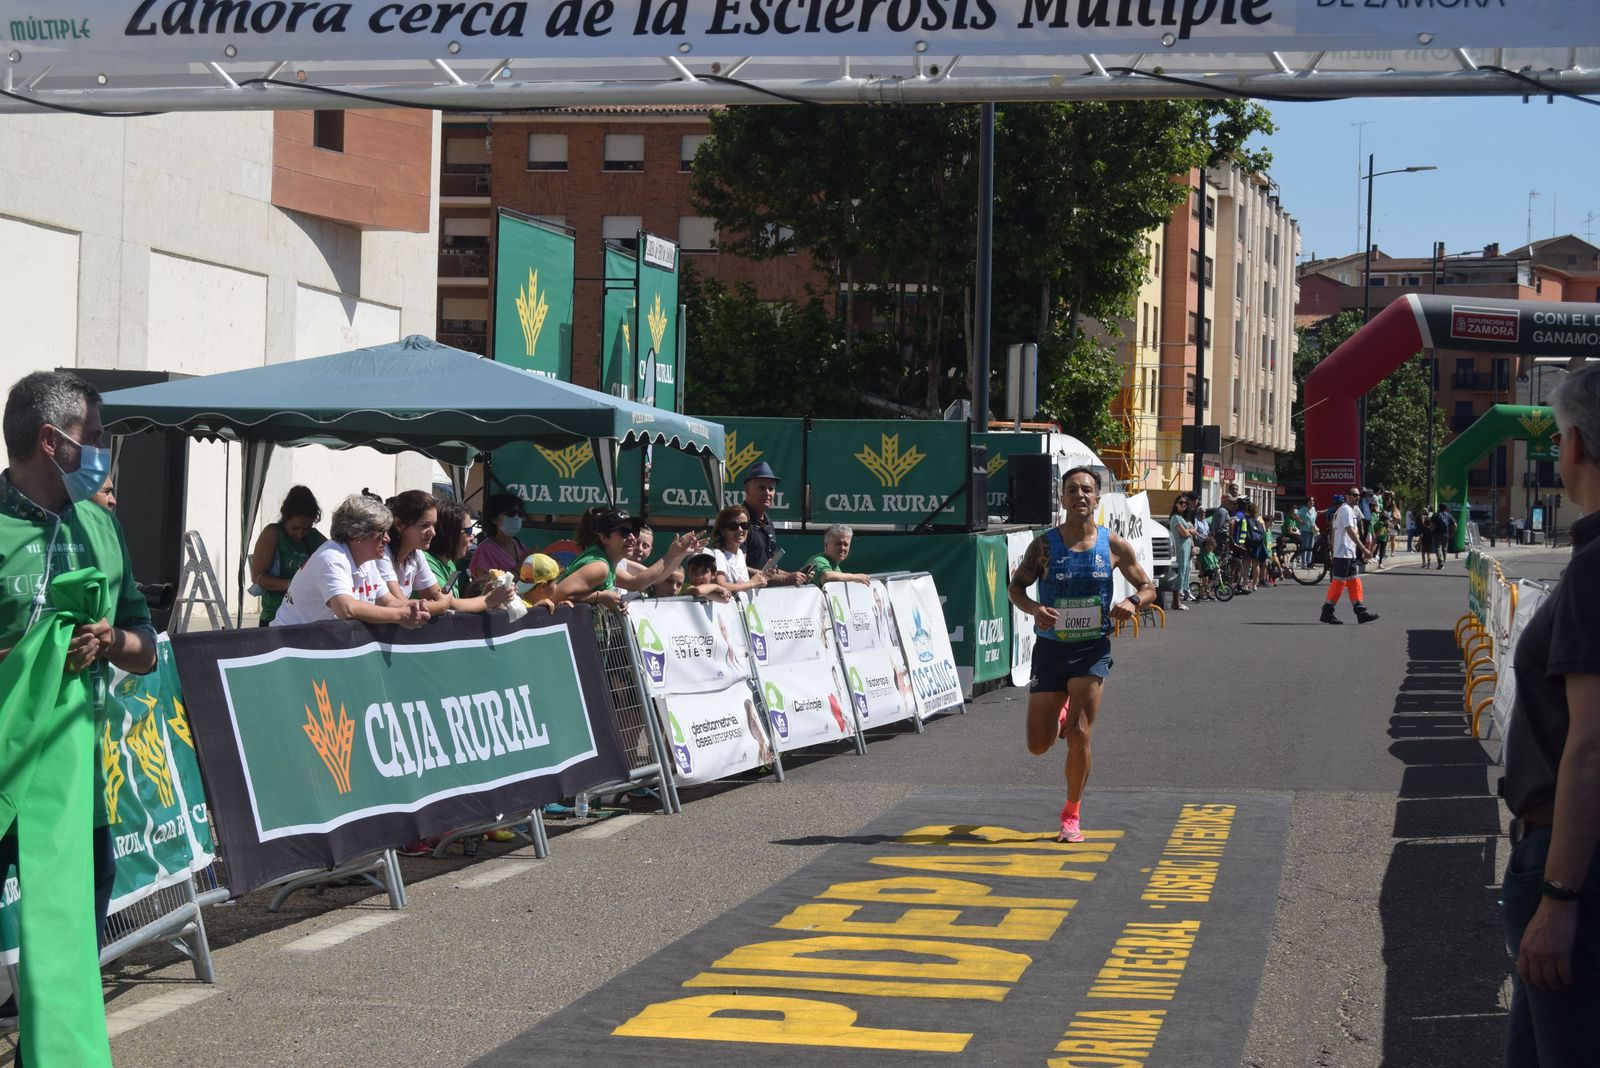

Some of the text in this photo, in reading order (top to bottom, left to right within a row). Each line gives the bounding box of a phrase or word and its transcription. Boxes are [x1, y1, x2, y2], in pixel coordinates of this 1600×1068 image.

[9, 15, 90, 41] MÚLTIPLE
[124, 0, 350, 36] Zamora
[368, 1, 527, 37] cerca
[545, 0, 614, 37] de
[633, 0, 691, 36] la
[705, 0, 997, 36] Esclerosis
[1533, 312, 1567, 326] CON
[1571, 314, 1590, 326] EL
[1467, 323, 1515, 336] ZAMORA
[1532, 330, 1600, 346] GANAMO
[1320, 472, 1354, 480] ZAMORA
[506, 484, 553, 503] CAJA
[662, 488, 790, 509] CAJA RUL
[825, 493, 955, 513] CAJA RURAL
[26, 543, 41, 554] VII
[1065, 617, 1091, 629] GOMEZ
[674, 645, 712, 659] abiea
[912, 659, 957, 700] OCEANIC
[365, 684, 550, 778] CAJA RURAL
[1163, 803, 1237, 857] INTERIORES
[1140, 859, 1220, 903] DISEÑO
[1087, 920, 1201, 1001] INTEGRAL
